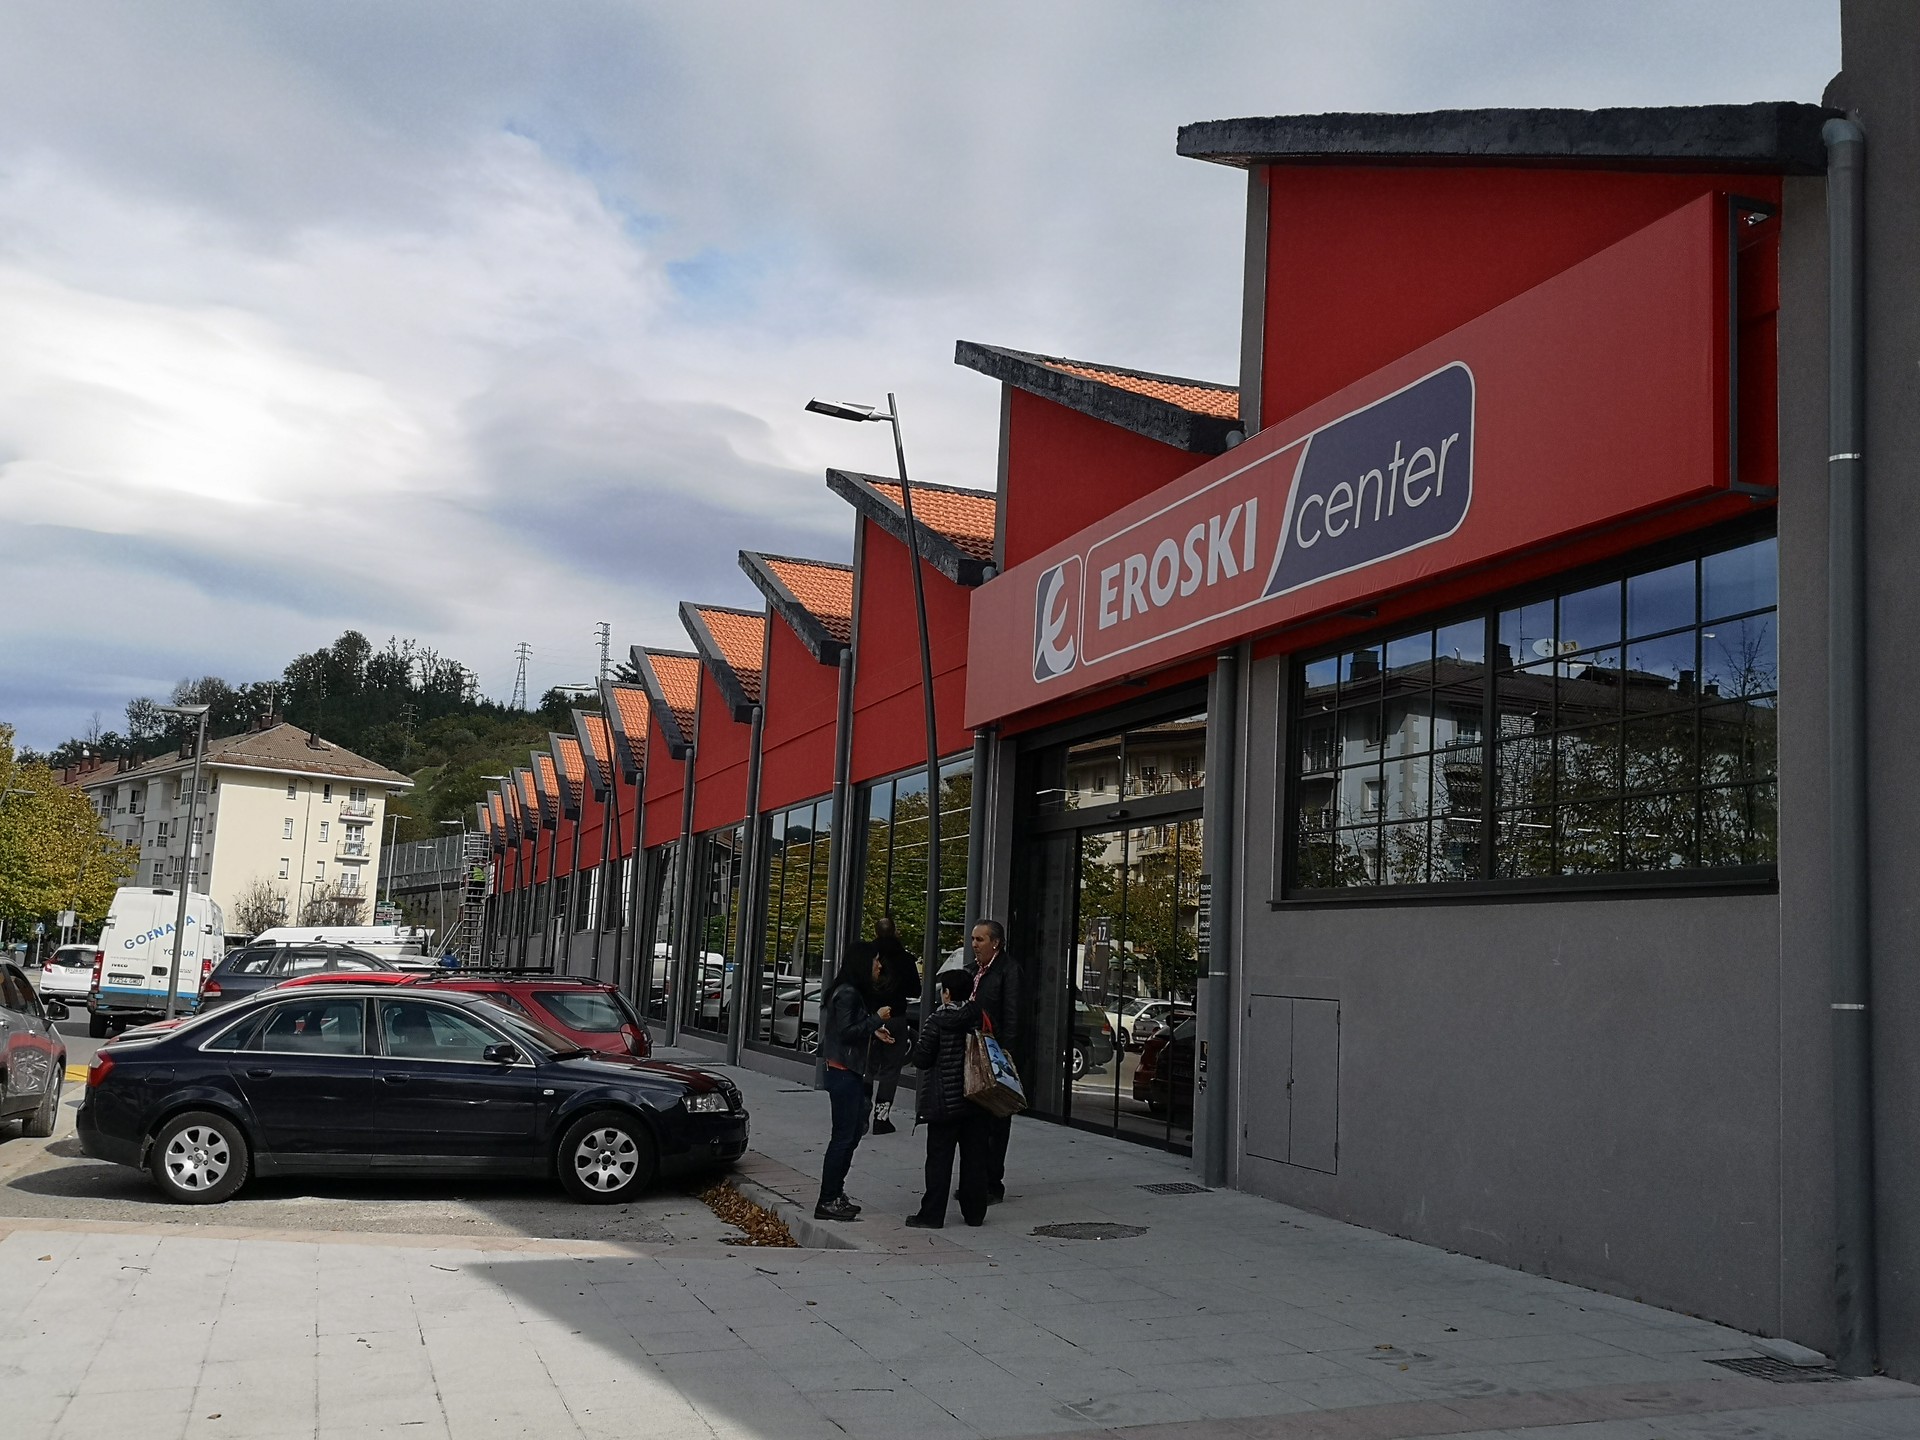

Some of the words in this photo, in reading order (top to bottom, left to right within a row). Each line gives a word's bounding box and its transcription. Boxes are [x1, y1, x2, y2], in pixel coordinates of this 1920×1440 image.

[1099, 497, 1258, 630] EROSKI
[1296, 432, 1459, 549] center
[124, 915, 196, 949] GOENAA
